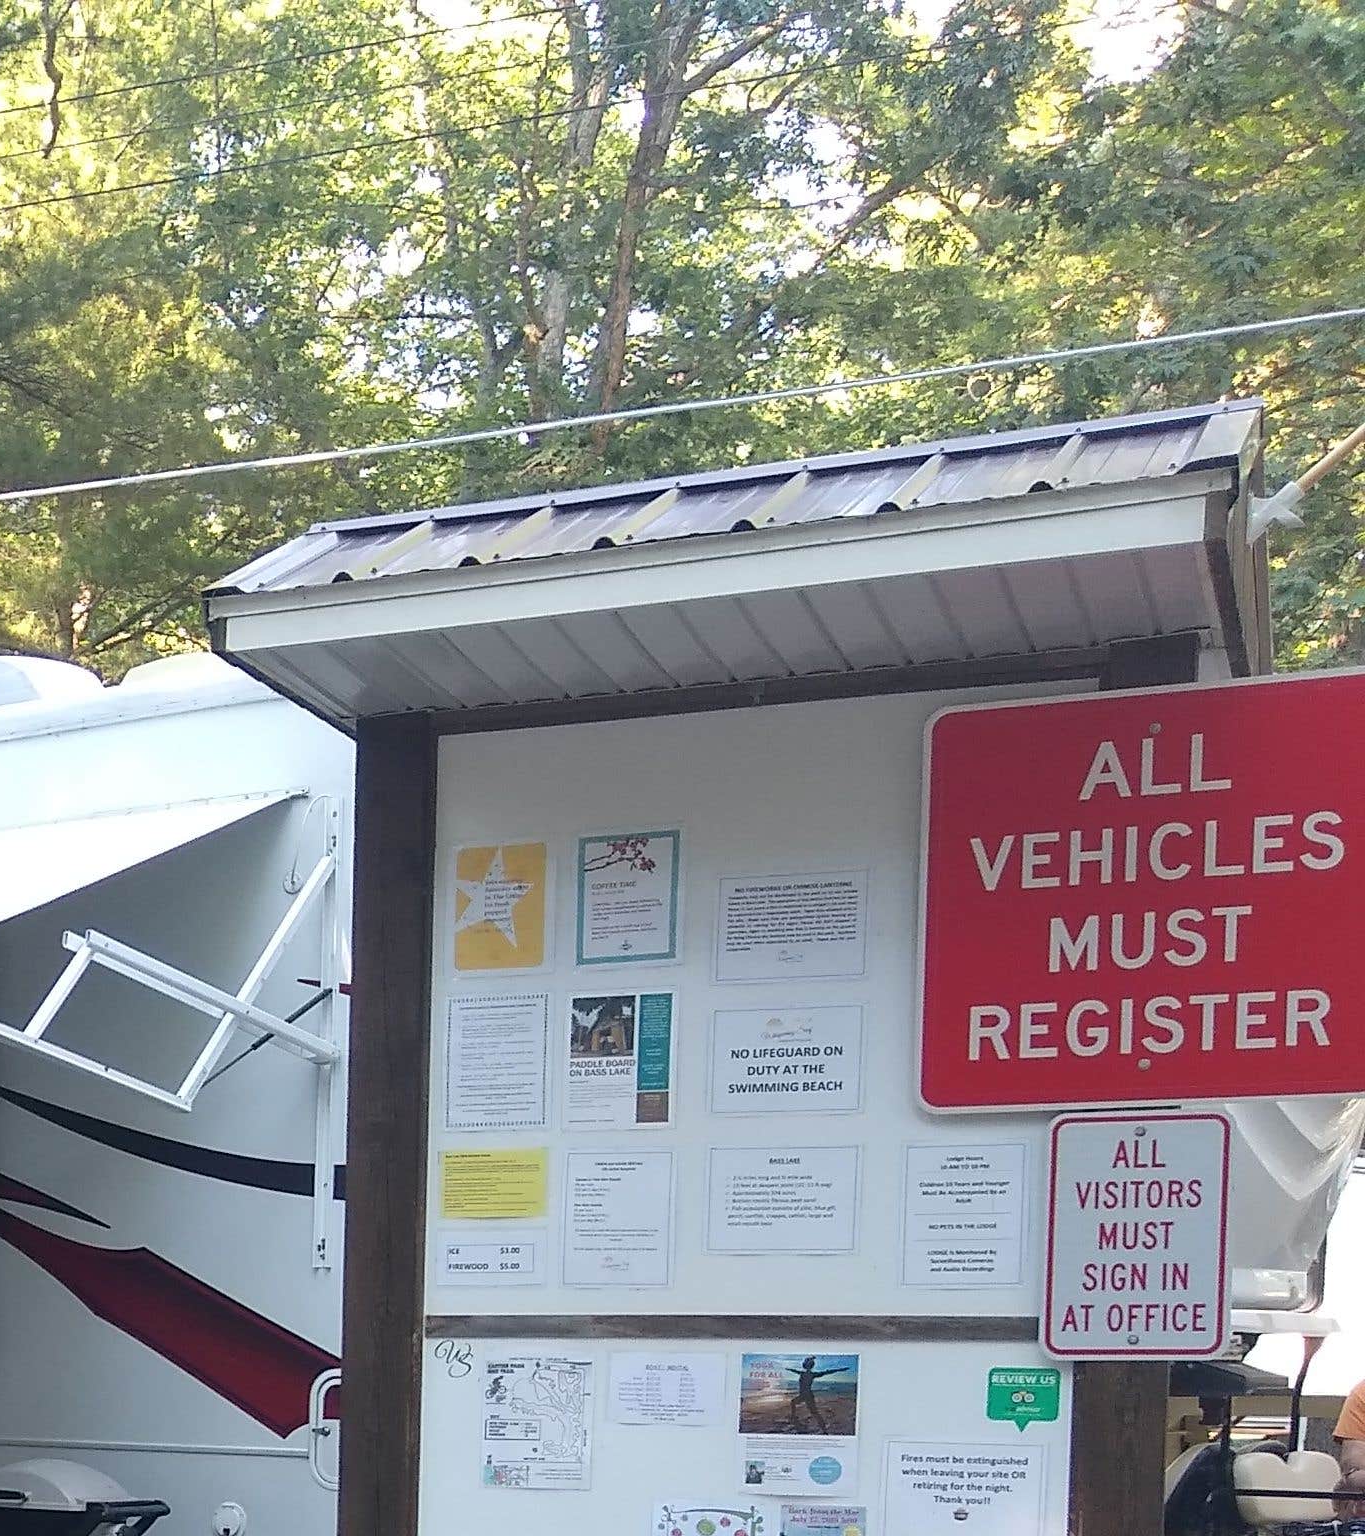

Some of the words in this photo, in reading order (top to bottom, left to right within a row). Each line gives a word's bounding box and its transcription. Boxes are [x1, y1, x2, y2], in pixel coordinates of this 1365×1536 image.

[1079, 733, 1232, 800] ALL
[970, 811, 1345, 891] VEHICLES
[1048, 905, 1252, 973] MUST
[968, 990, 1331, 1060] REGISTER
[731, 1049, 749, 1059] NO
[753, 1047, 820, 1058] LIFEGUARD
[824, 1046, 843, 1056] ON
[570, 1061, 604, 1069] PADDLE
[606, 1059, 636, 1067] BOARD
[747, 1065, 780, 1076] DUTY
[783, 1065, 799, 1074] AT
[802, 1064, 825, 1074] THE
[569, 1069, 582, 1077] ON
[609, 1068, 631, 1076] LAKE
[728, 1082, 799, 1093] SWIMMING
[802, 1081, 843, 1091] BEACH
[1112, 1139, 1166, 1170] ALL
[1075, 1180, 1202, 1210] VISITORS
[1098, 1221, 1173, 1250] MUST
[1082, 1263, 1152, 1292] SIGN
[1162, 1263, 1189, 1291] IN
[1061, 1304, 1097, 1334] AT
[1108, 1303, 1207, 1332] OFFICE
[991, 1374, 1037, 1384] REVIEW
[1040, 1375, 1057, 1384] US
[901, 1454, 923, 1463] Fires
[952, 1455, 964, 1464] be
[967, 1457, 1028, 1466] extinguished
[931, 1469, 964, 1478] leaving
[967, 1471, 989, 1479] your
[992, 1470, 1009, 1478] site
[1011, 1471, 1026, 1479] OR
[913, 1482, 948, 1492] retiring
[950, 1483, 964, 1491] for
[966, 1484, 983, 1492] the
[985, 1484, 1013, 1493] night.
[934, 1496, 962, 1504] Thank
[965, 1497, 991, 1505] you!!
